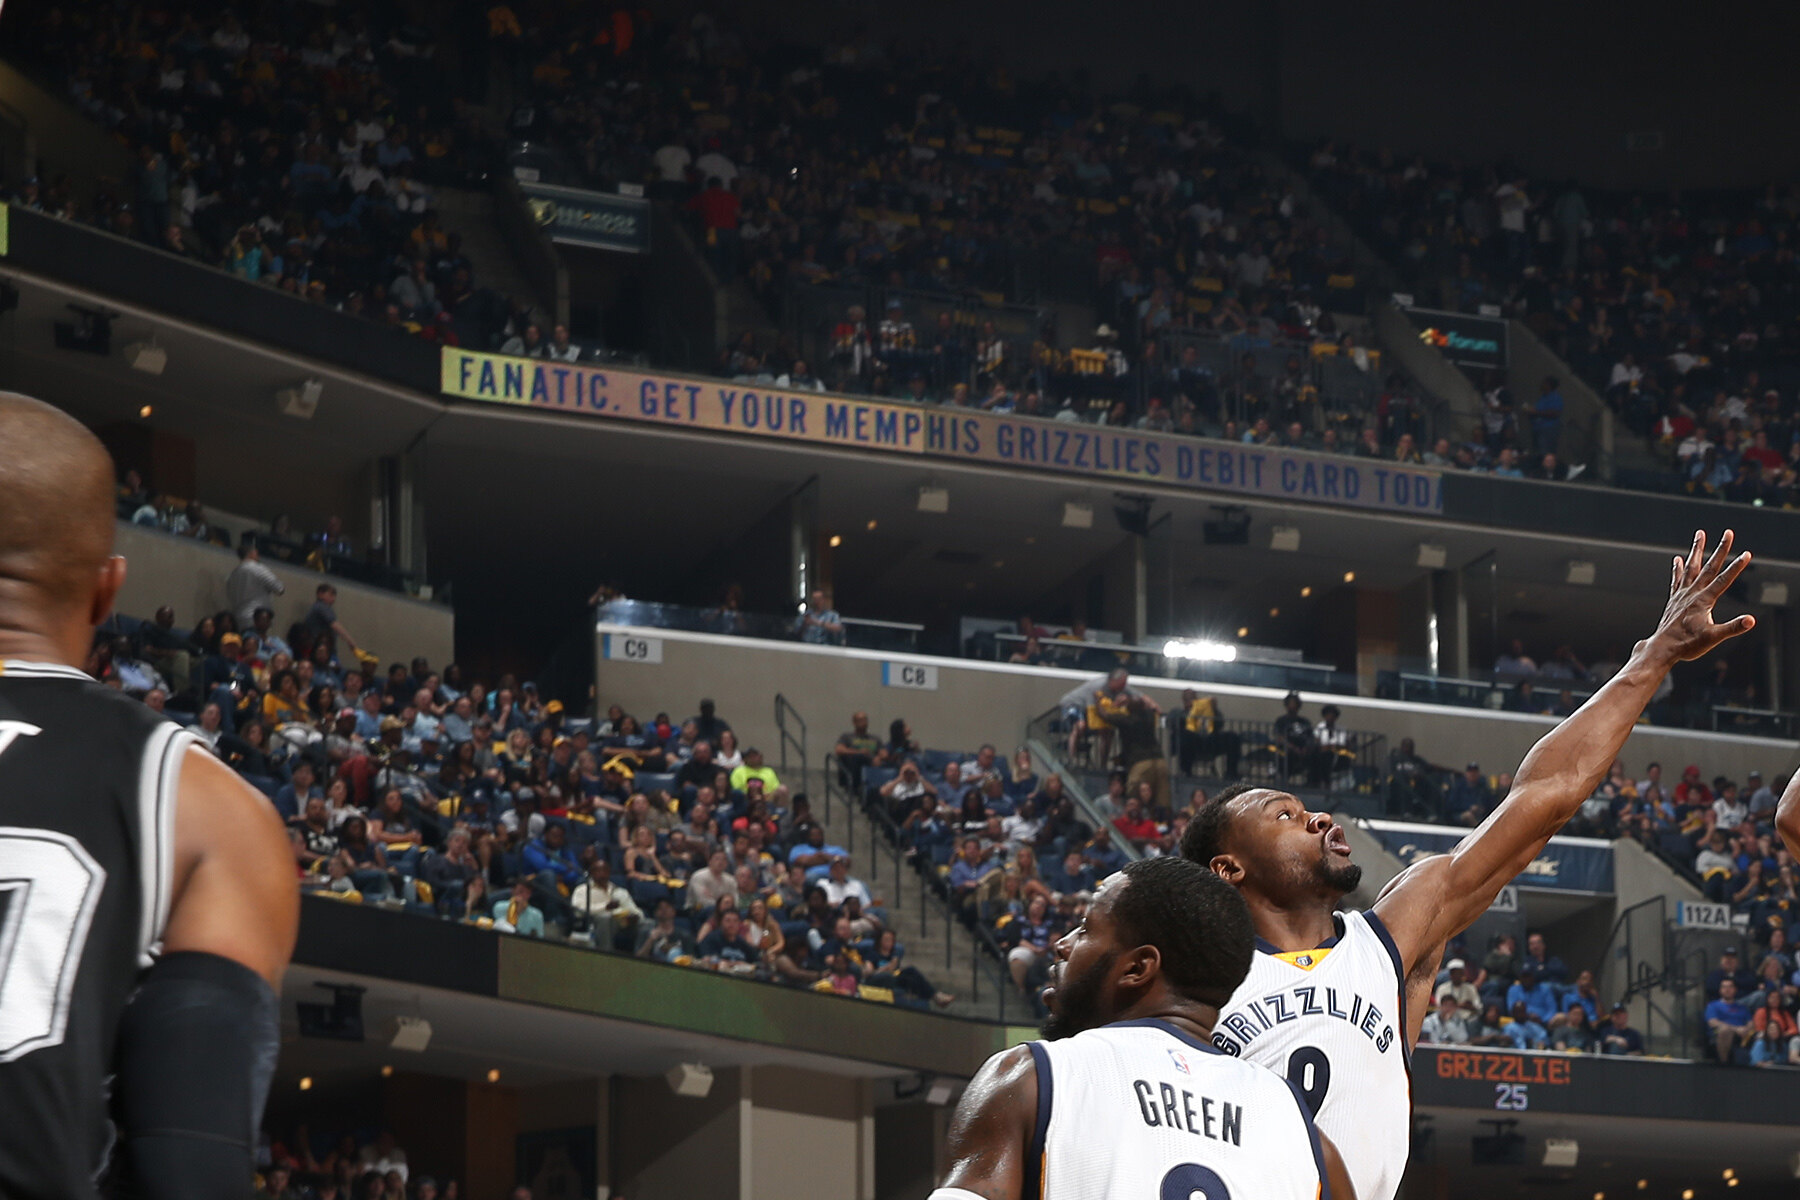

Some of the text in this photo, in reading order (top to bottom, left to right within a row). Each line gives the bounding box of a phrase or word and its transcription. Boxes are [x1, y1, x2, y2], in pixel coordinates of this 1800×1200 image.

[460, 356, 620, 412] FANATIC.
[640, 380, 702, 422] GET
[719, 389, 808, 434] YOUR
[825, 403, 981, 455] MEMPHIS
[997, 424, 1162, 476] GRIZZLIES
[1177, 445, 1266, 489] DEBIT
[1281, 459, 1361, 500] CARD
[624, 638, 648, 660] C9
[902, 666, 926, 685] C8
[1684, 904, 1726, 927] 112A
[1210, 986, 1395, 1058] GRIZZLIES
[1495, 1082, 1528, 1112] 25
[1133, 1078, 1243, 1147] GREEN
